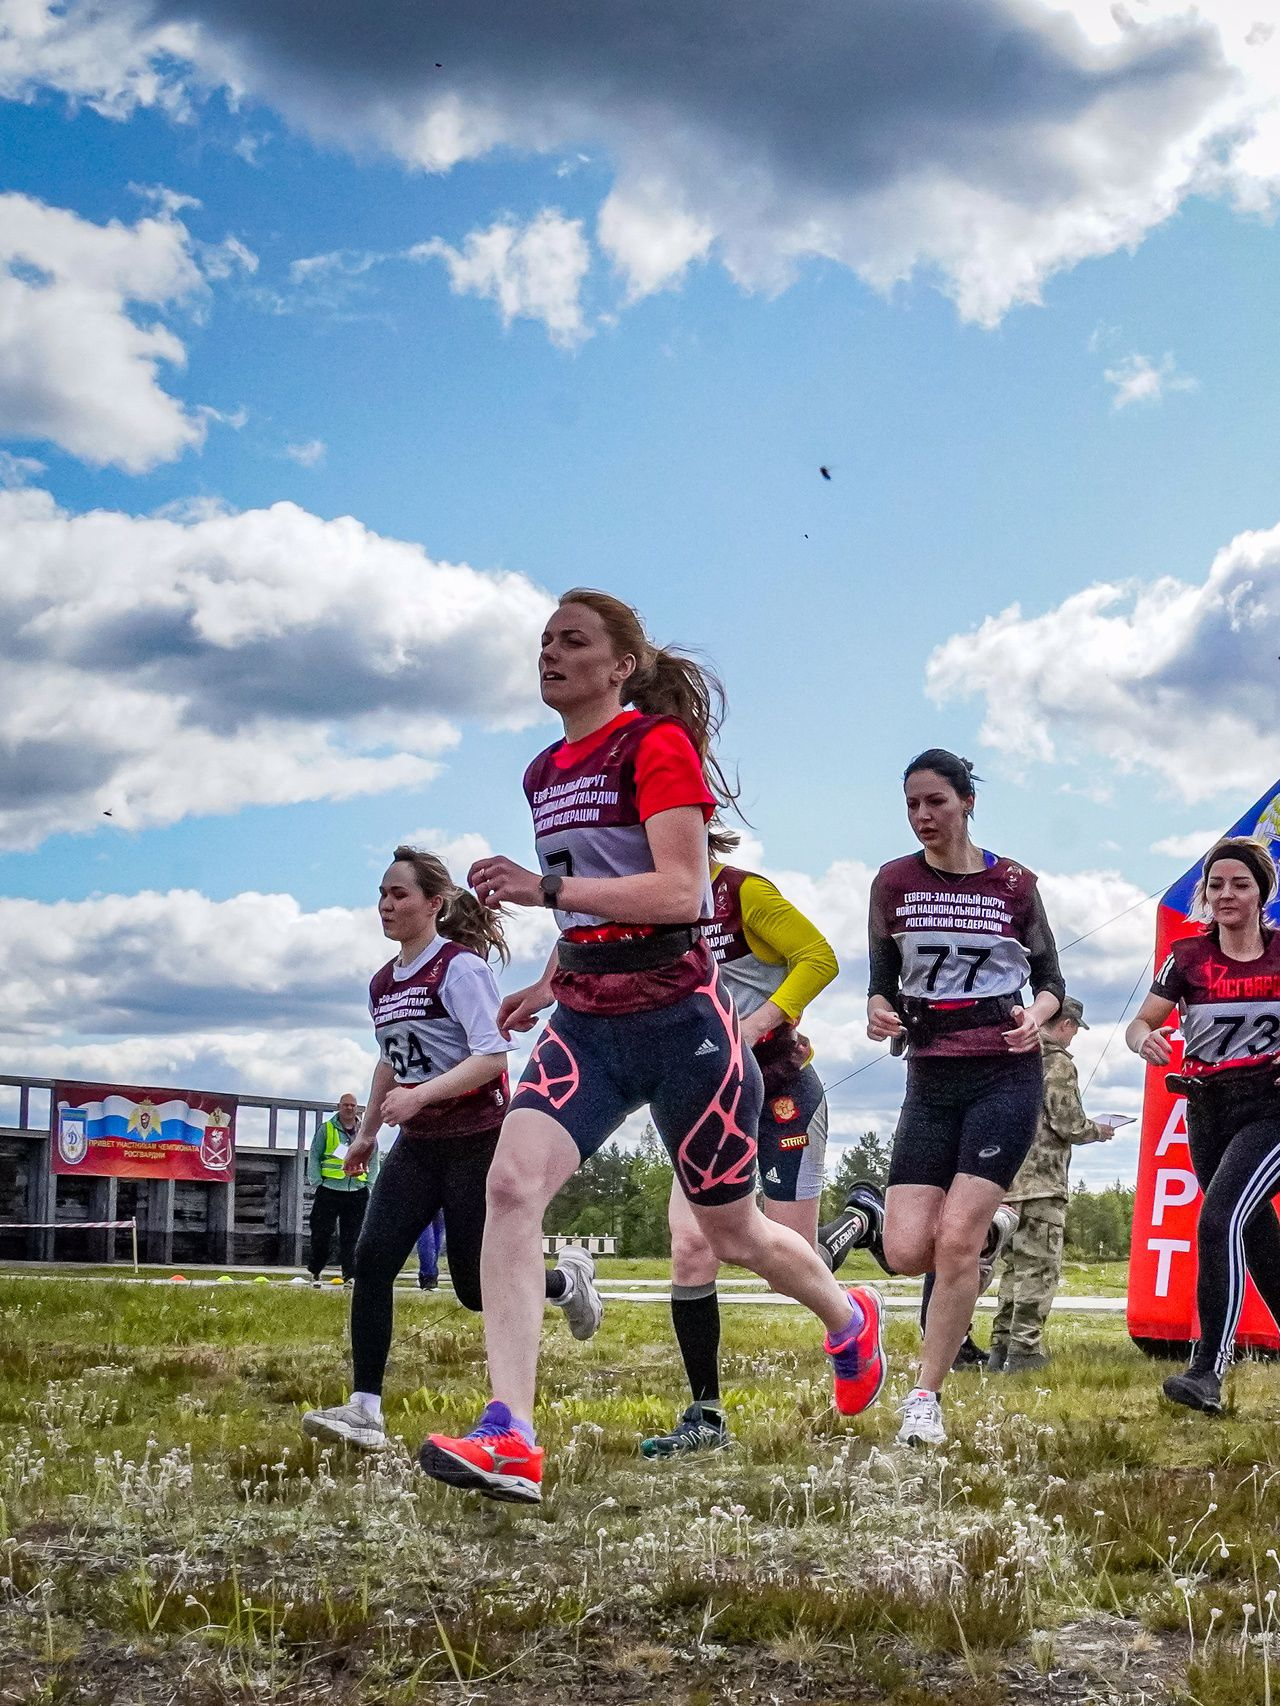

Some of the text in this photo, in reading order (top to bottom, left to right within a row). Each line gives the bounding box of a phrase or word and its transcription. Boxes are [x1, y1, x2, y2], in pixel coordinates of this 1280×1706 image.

[904, 892, 1006, 910] СЕВЕРО-ЗАПАДНЫЙ ОКРУГ
[917, 904, 981, 917] НАЦИОНАЛЬНОЙ
[917, 944, 992, 993] 77
[384, 1031, 432, 1078] 64
[1211, 1014, 1280, 1056] 73
